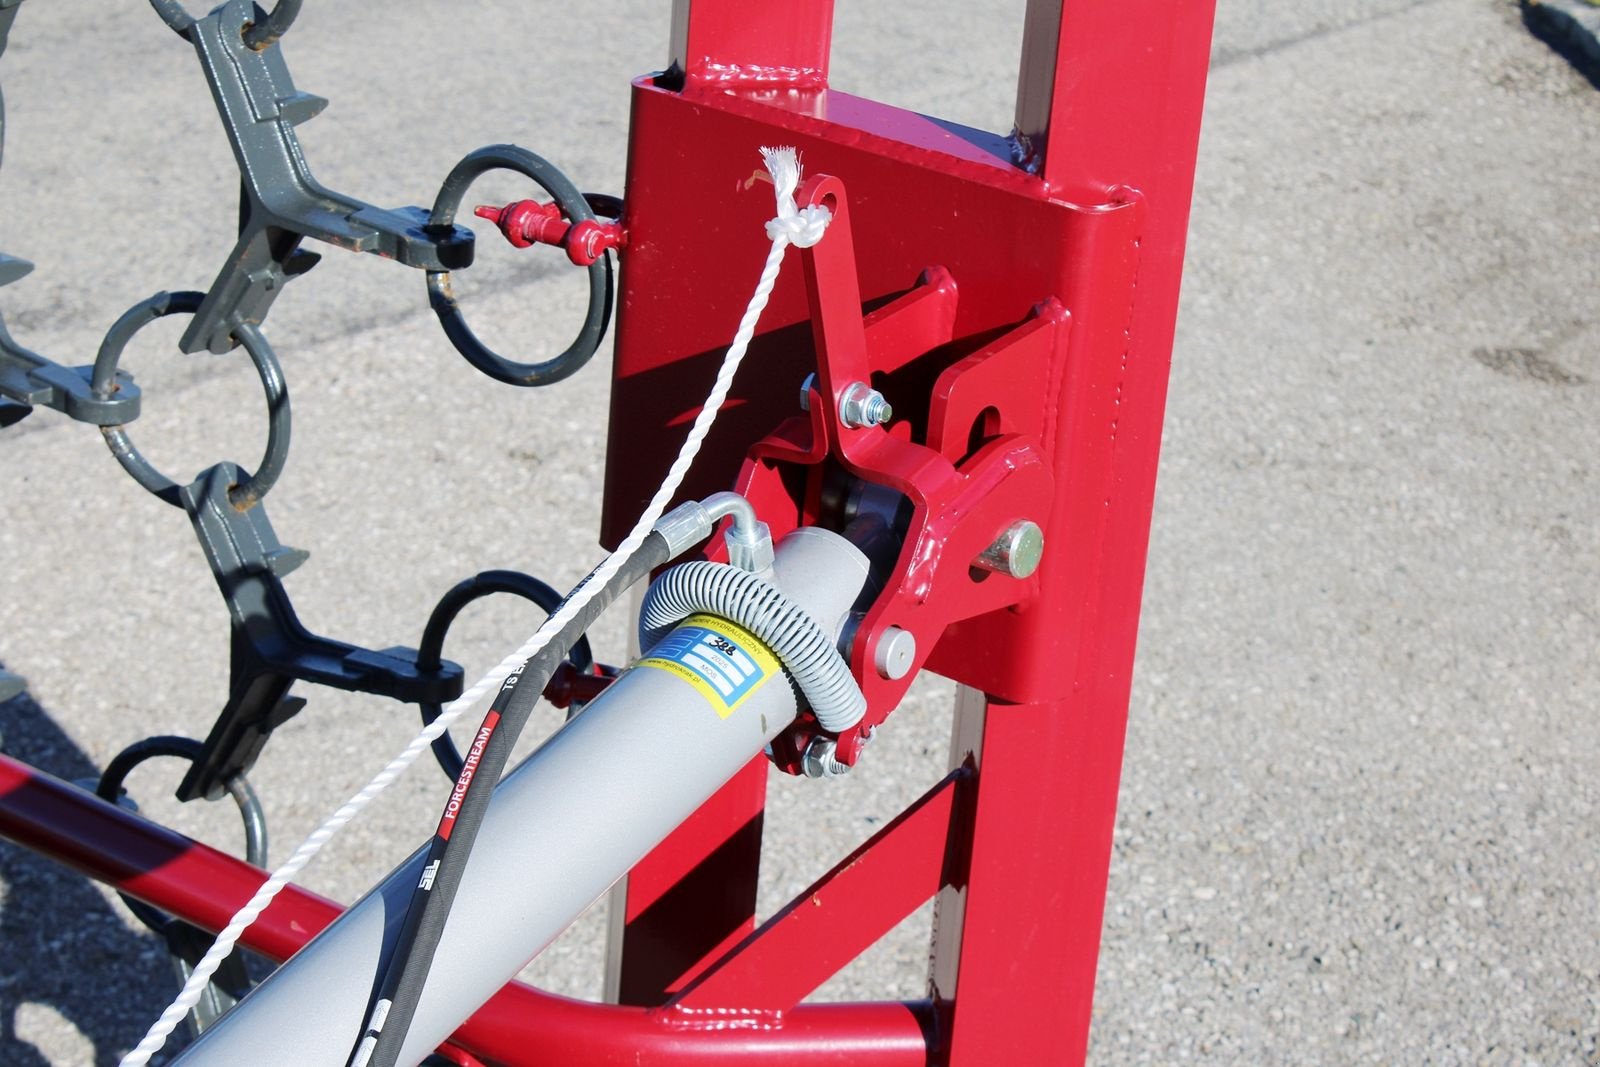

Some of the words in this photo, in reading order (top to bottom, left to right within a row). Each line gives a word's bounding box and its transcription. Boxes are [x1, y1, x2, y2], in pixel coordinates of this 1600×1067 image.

[709, 636, 737, 656] 388
[711, 620, 762, 655] HYDRAULICZNY
[502, 676, 518, 691] TS
[445, 727, 491, 819] FORCESTREAM
[418, 860, 440, 891] SEL
